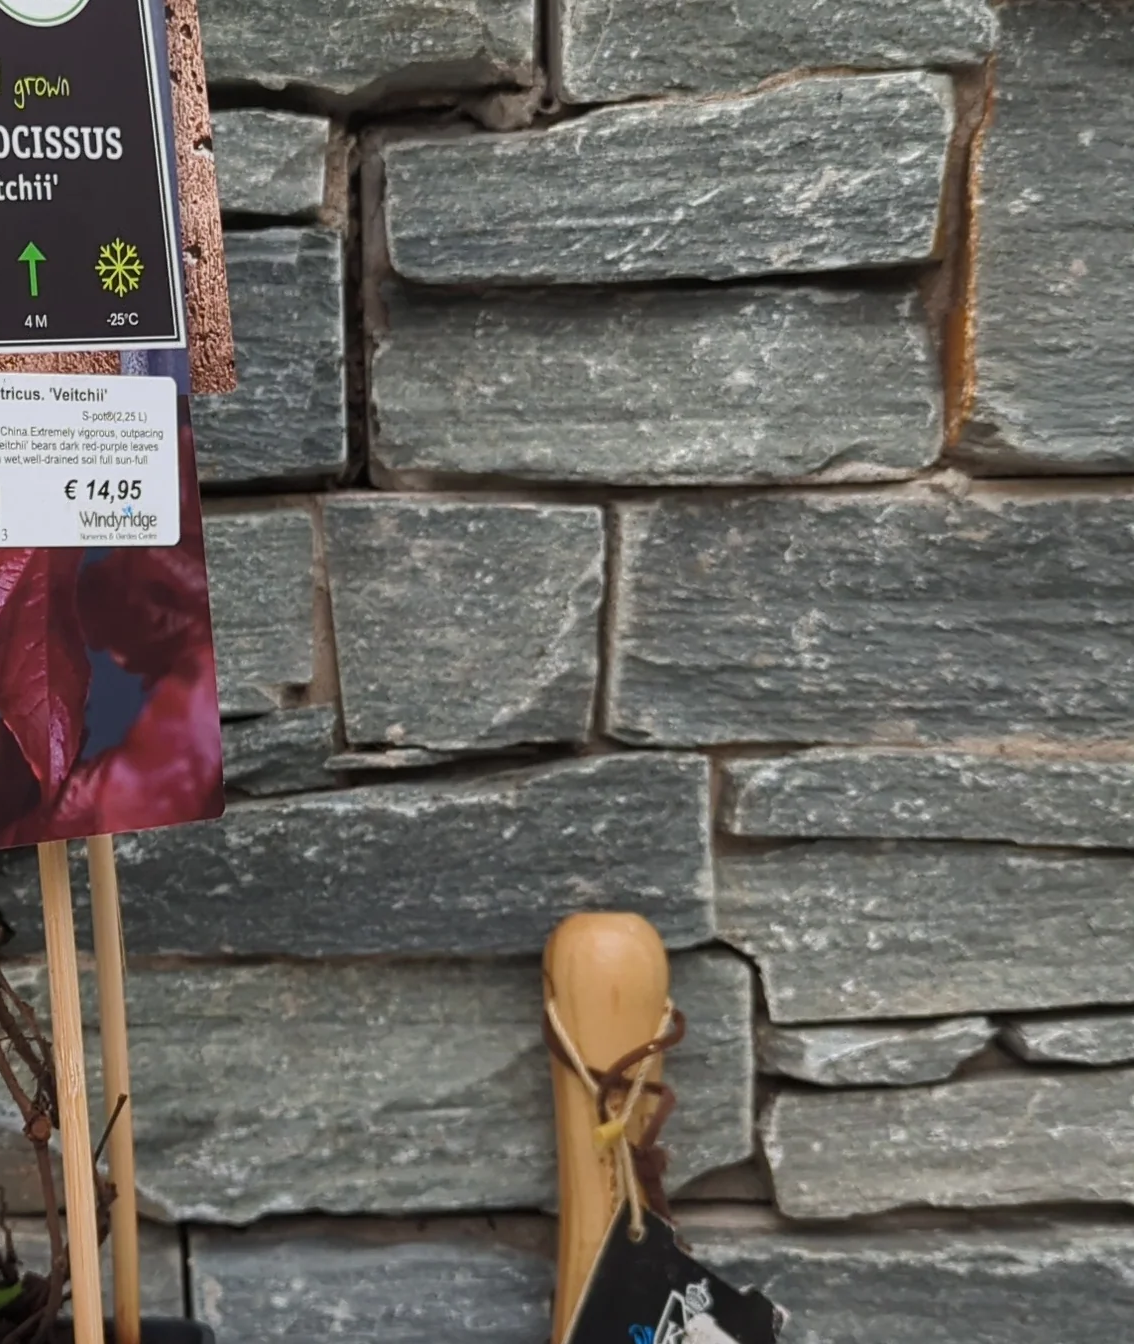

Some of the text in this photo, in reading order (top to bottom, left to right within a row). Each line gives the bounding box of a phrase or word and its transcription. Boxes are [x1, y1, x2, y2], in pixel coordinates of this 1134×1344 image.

[13, 75, 71, 109] grown
[24, 314, 48, 329] 4 M
[106, 312, 140, 327] -25°C
[0, 387, 45, 401] tricus.
[49, 387, 108, 402] 'Veitchii'
[78, 428, 118, 440] vigorous,
[120, 429, 164, 440] outpacing
[31, 441, 57, 451] bears
[60, 441, 80, 451] dark
[82, 442, 128, 454] red-purple
[130, 442, 159, 452] leaves
[81, 455, 97, 465] soil
[99, 455, 113, 465] full
[115, 455, 148, 466] sun-full
[64, 479, 142, 504] € 14,95
[1, 528, 9, 542] 3
